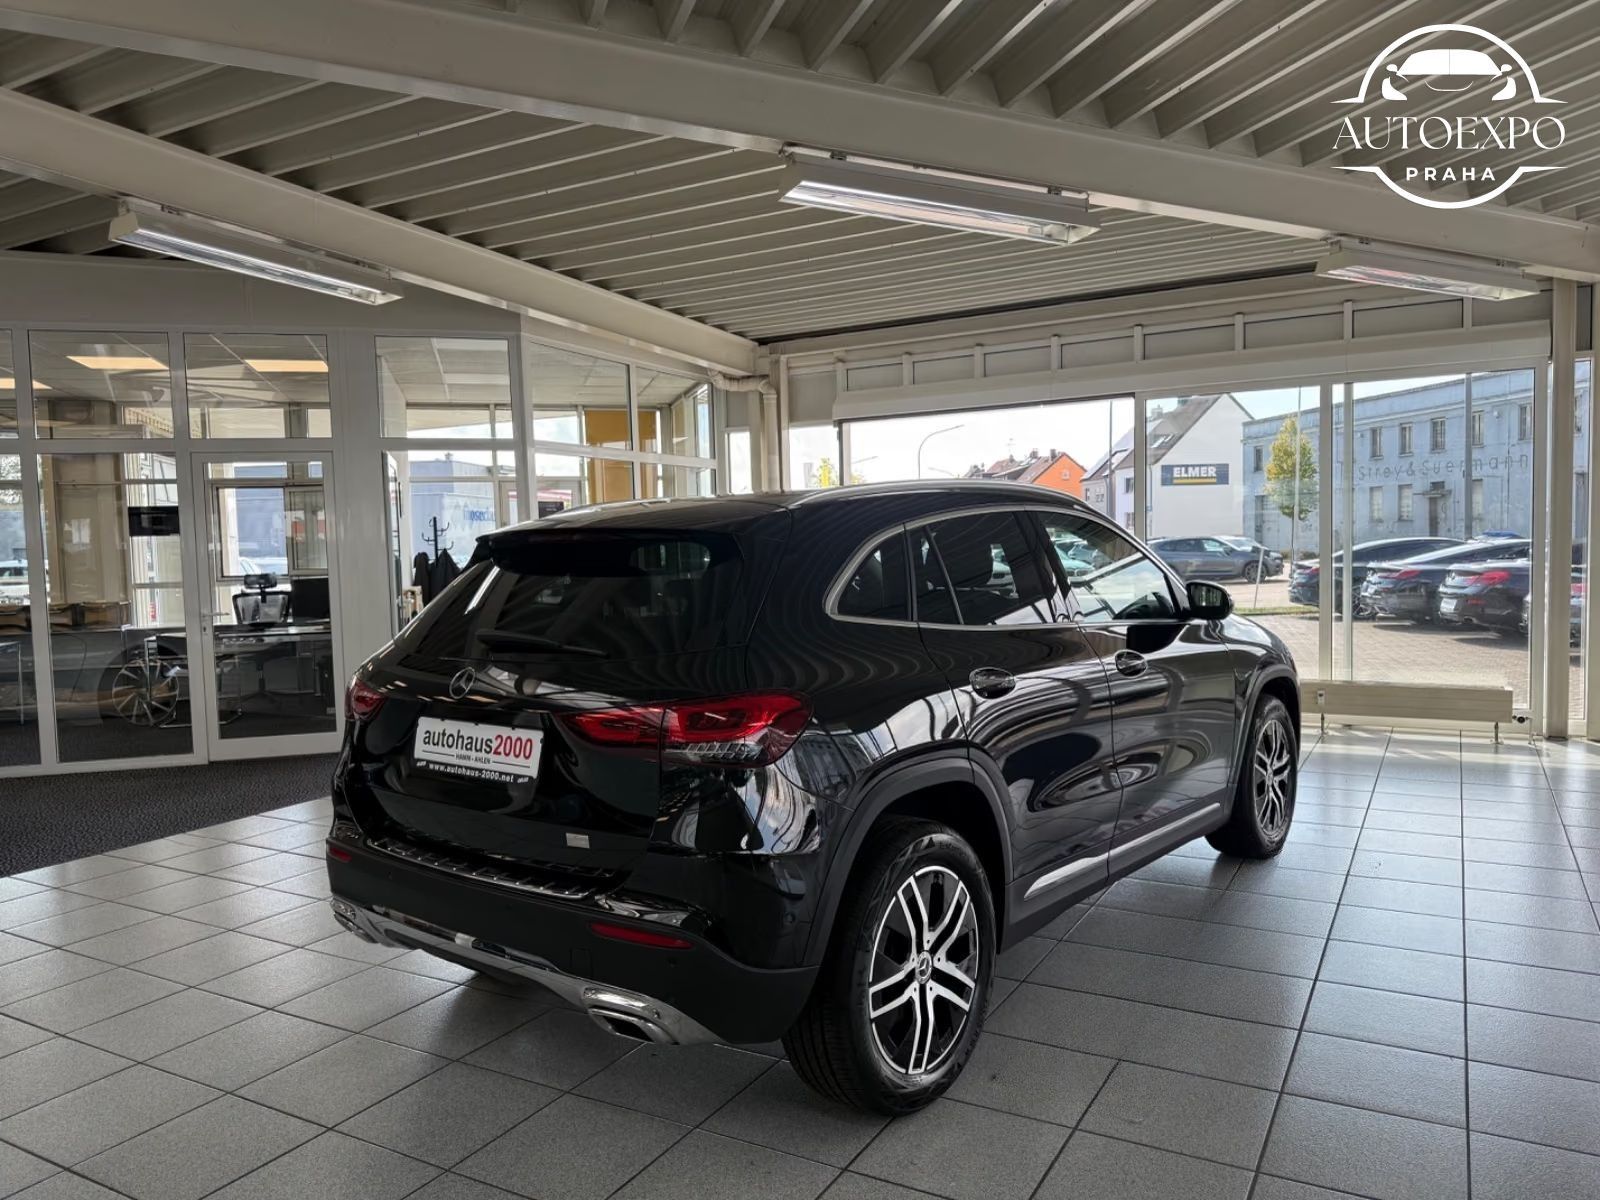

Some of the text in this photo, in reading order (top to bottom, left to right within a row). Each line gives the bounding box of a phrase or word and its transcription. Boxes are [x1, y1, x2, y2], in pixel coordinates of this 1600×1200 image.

[1173, 466, 1217, 477] ELMER
[423, 728, 533, 760] autohaus2000
[429, 763, 514, 782] www.autohaus-2000.net
